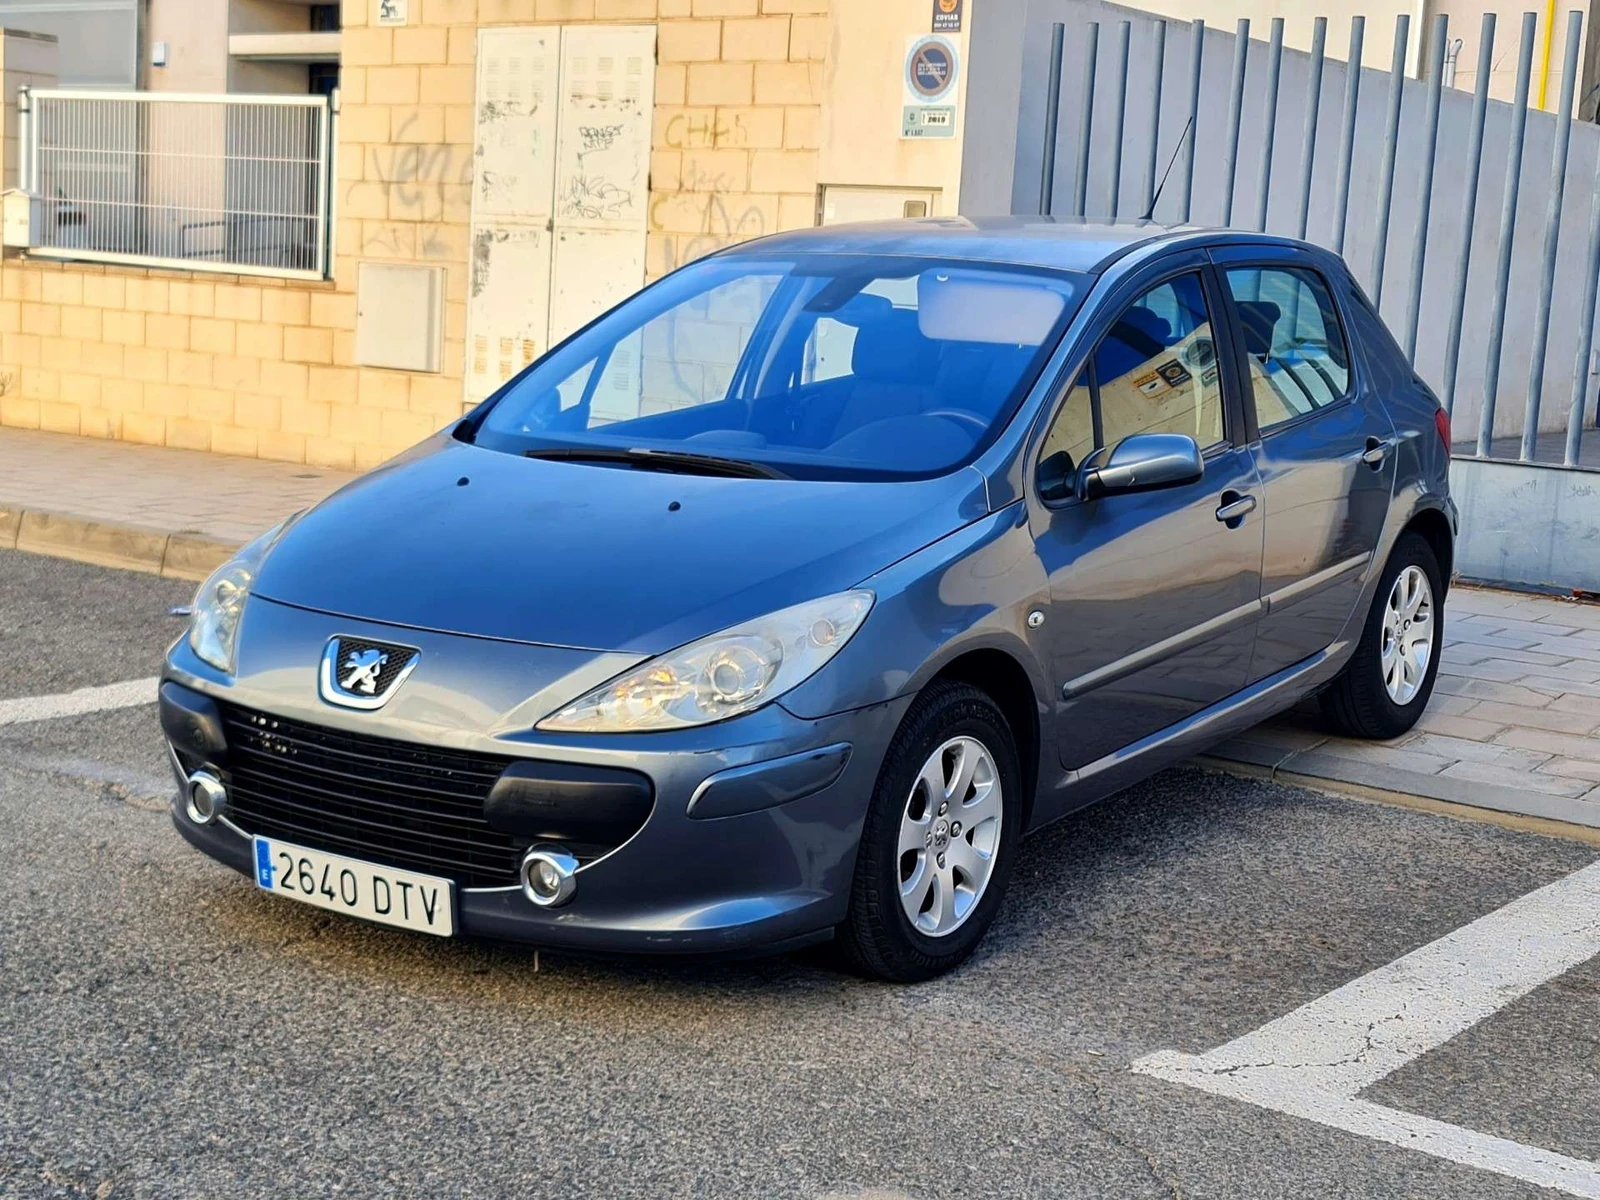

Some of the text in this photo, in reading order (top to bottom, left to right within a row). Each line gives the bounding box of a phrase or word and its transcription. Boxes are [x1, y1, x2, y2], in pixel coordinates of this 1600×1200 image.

[262, 852, 438, 925] E 2640 DTV
